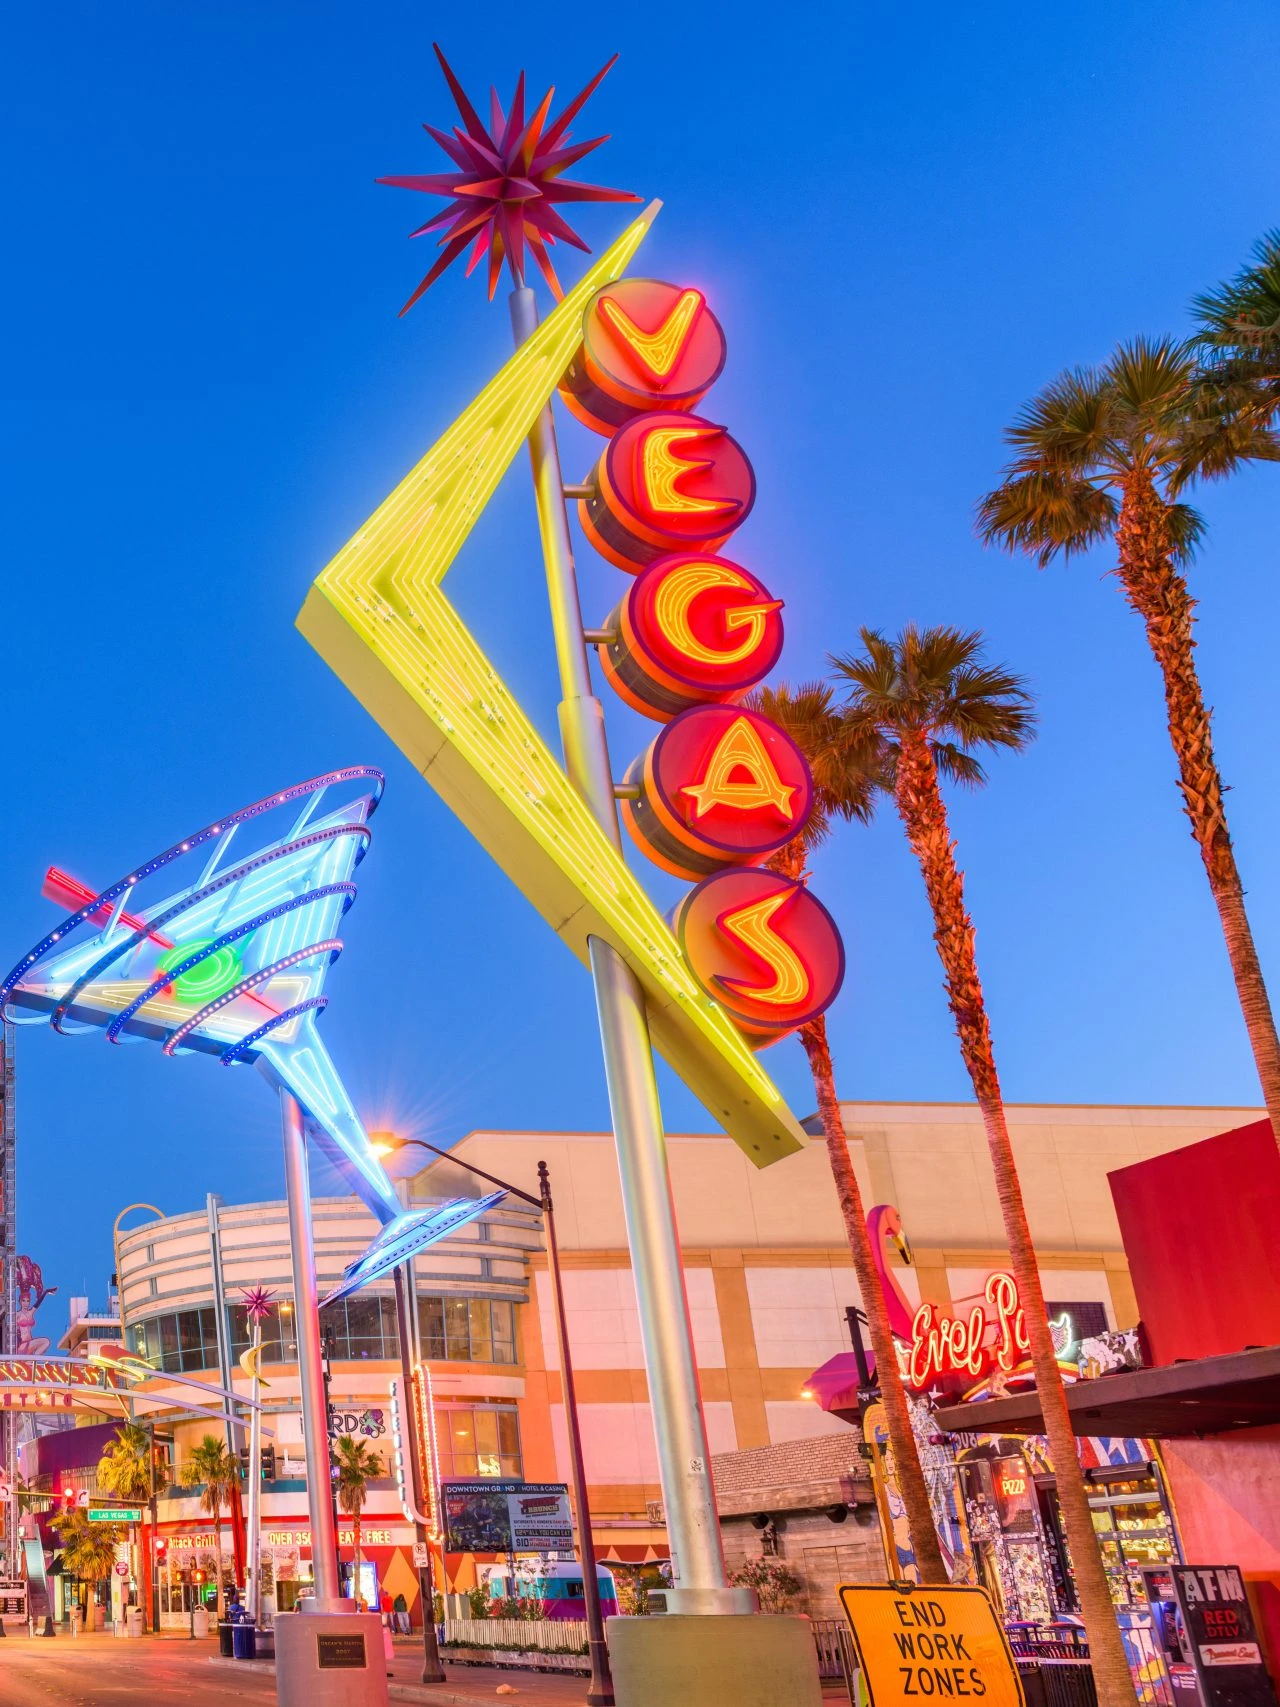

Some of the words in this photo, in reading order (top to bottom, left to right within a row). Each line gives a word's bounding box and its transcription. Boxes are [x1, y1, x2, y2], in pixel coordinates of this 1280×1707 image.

[598, 288, 810, 1005] VEGAS
[909, 1303, 985, 1388] Evel
[985, 1272, 1031, 1371] Pi
[447, 1485, 490, 1493] DOWNTOWN
[1002, 1479, 1026, 1496] PIZZA
[528, 1504, 559, 1513] BRUNCH
[168, 1536, 193, 1549] Attack
[195, 1534, 216, 1548] Grill
[269, 1531, 293, 1545] OVER
[366, 1530, 391, 1544] FREE
[1184, 1569, 1246, 1602] ATM
[894, 1600, 946, 1627] END
[1203, 1609, 1238, 1624] RED
[1207, 1625, 1239, 1638] DTLV
[893, 1632, 972, 1660] WORK
[899, 1667, 986, 1696] ZONES
